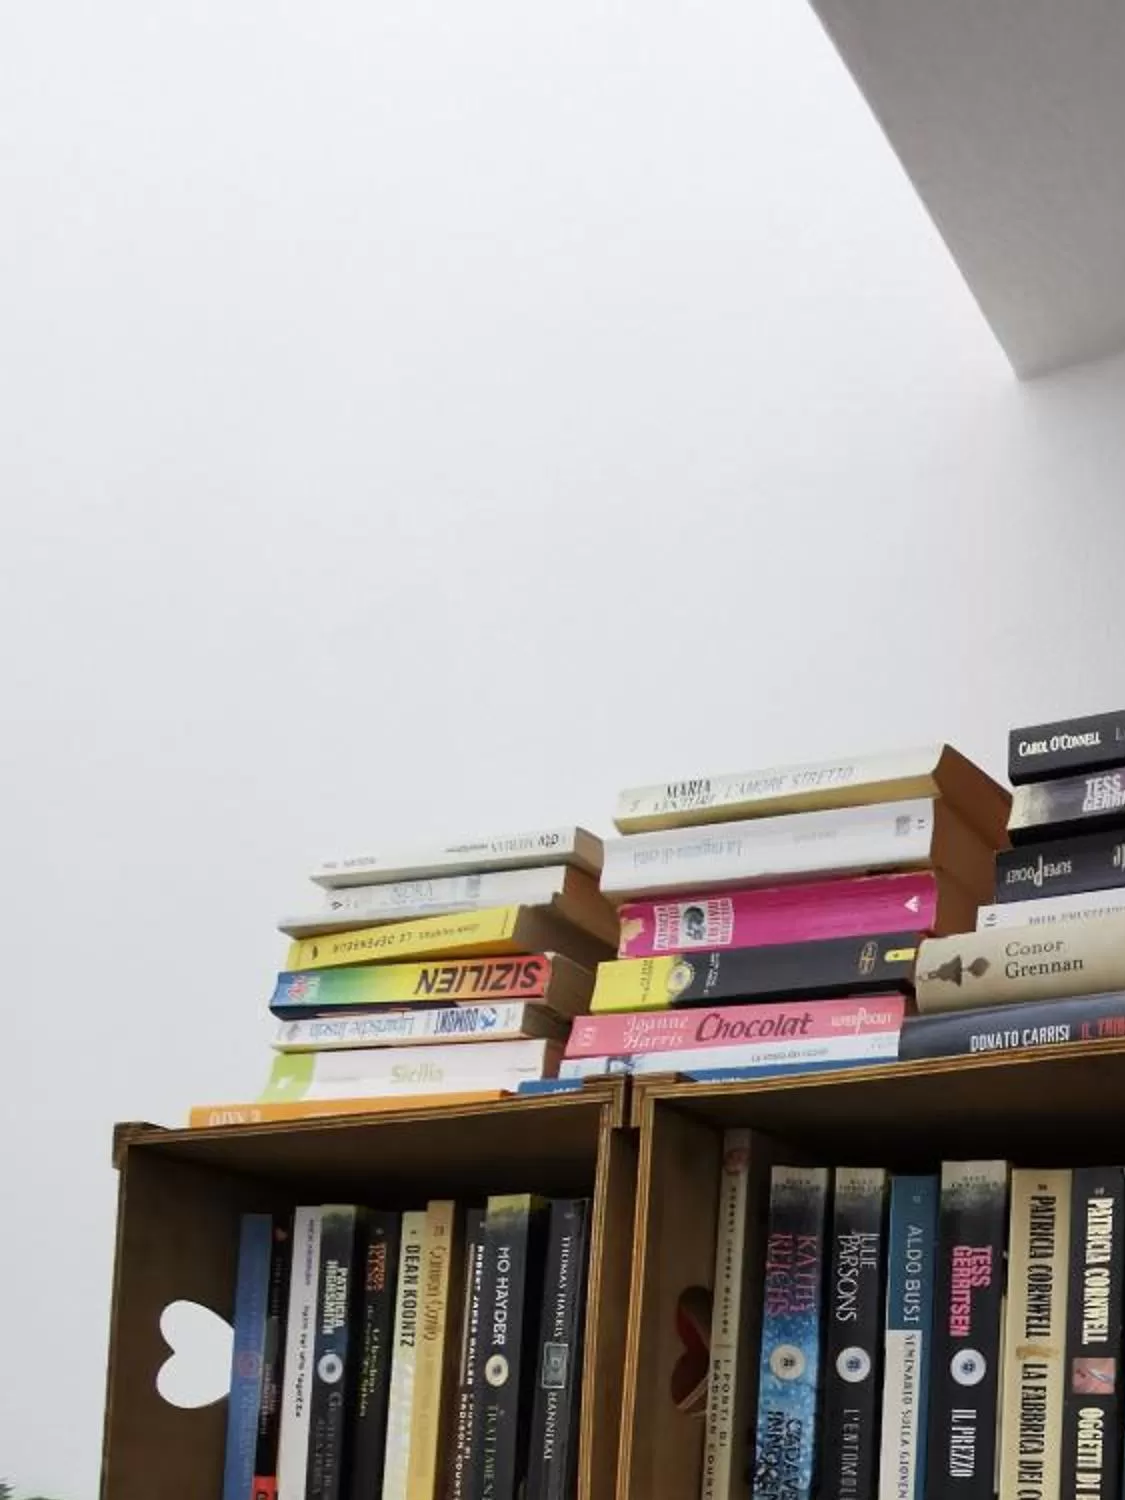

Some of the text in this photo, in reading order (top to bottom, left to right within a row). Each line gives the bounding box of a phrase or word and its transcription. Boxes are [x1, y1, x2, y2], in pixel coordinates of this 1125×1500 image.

[1085, 773, 1122, 794] TESS
[1004, 956, 1085, 980] Grennan
[1005, 938, 1066, 960] Conor
[413, 960, 543, 996] SIZILIEN
[622, 1030, 685, 1049] Harris
[626, 1013, 690, 1034] Joanne
[695, 1010, 816, 1043] Chocolat
[970, 1023, 1072, 1053] DONATO CARRISI
[835, 1232, 861, 1323] PARSONS
[902, 1224, 925, 1323] ALDO BUSI
[975, 1244, 994, 1288] TESS
[1025, 1195, 1056, 1339] PATRICIA CORNWELL
[1081, 1197, 1115, 1345] PATRICIA CORNWELL
[400, 1244, 421, 1348] DEAN KOONTZ
[493, 1247, 511, 1346] MO HAYDER
[949, 1245, 975, 1338] GERRITSEN
[1022, 1363, 1047, 1381] LA
[1018, 1384, 1046, 1455] FABBRICA
[1076, 1407, 1105, 1469] OGGETTI
[950, 1407, 977, 1479] IL PREZZO
[1018, 1459, 1043, 1485] DEI
[1077, 1472, 1102, 1489] DI
